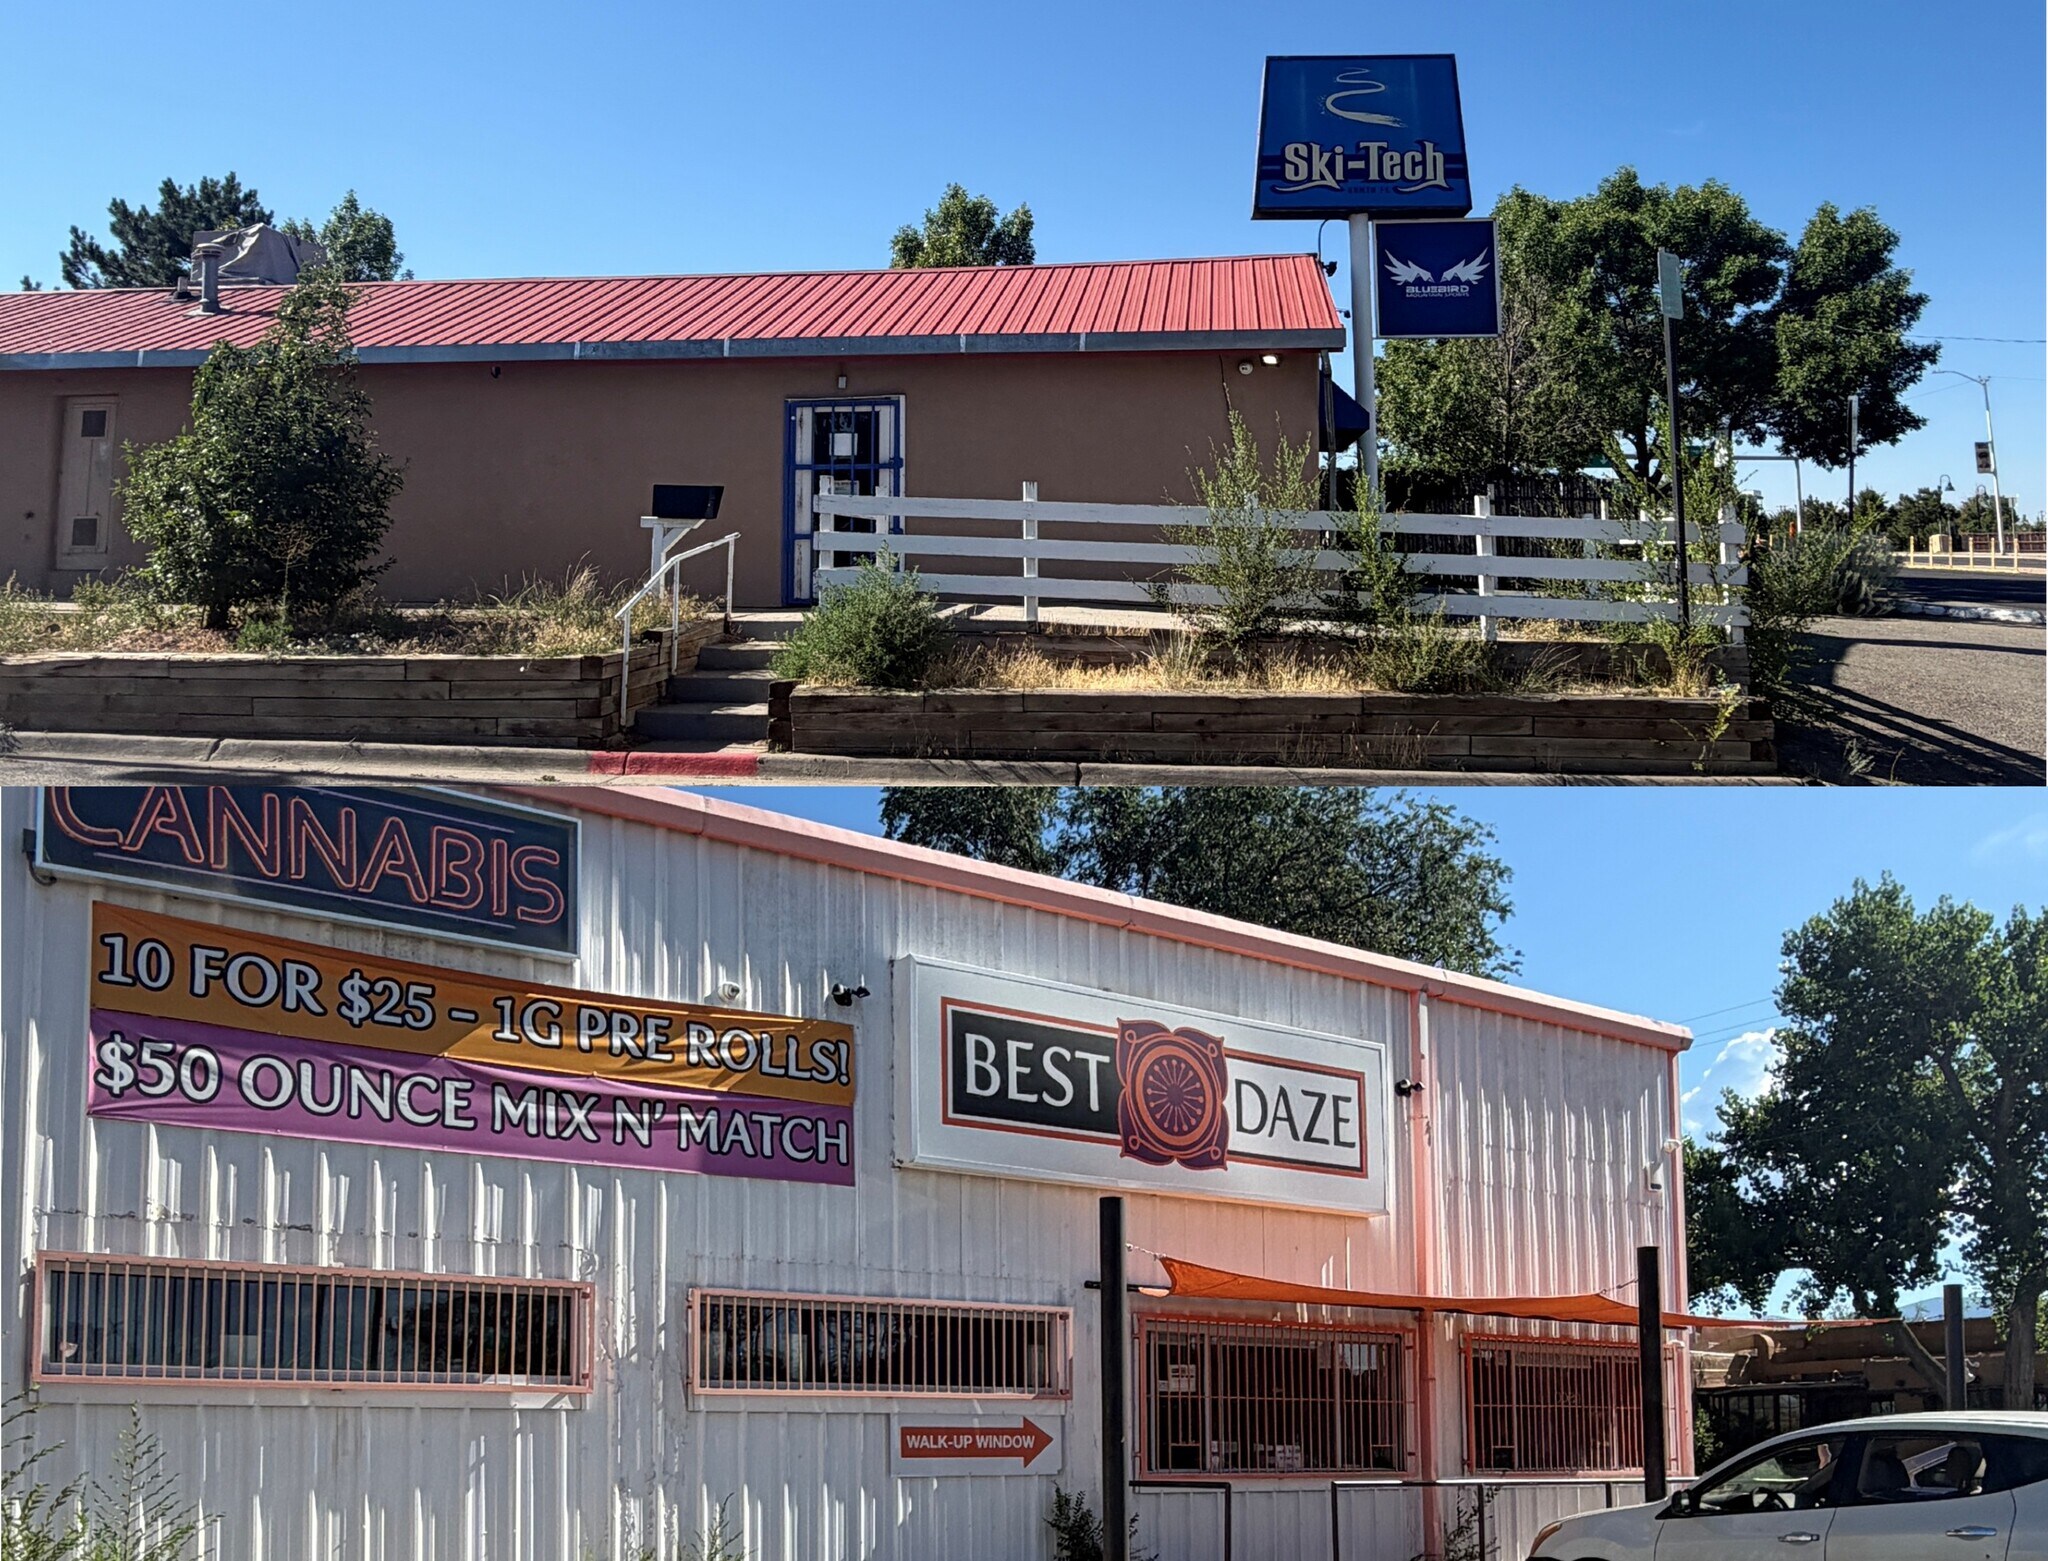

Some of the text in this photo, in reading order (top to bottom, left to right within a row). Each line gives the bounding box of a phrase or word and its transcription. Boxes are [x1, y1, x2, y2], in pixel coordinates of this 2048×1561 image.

[1274, 140, 1451, 192] Ski-Tech
[1405, 285, 1470, 293] BLUEBIRD
[100, 932, 174, 991] 10
[189, 944, 327, 1016] FOR
[337, 968, 436, 1030] $25
[492, 995, 563, 1050] 1G
[576, 1005, 675, 1063] PRE
[686, 1020, 851, 1085] ROLLS!
[95, 1031, 222, 1103] $50
[238, 1054, 478, 1131] OUNCE
[491, 1082, 599, 1142] MIX
[677, 1104, 850, 1167] MATCH
[964, 1033, 1358, 1149] BEST DAZE
[906, 1434, 1035, 1449] WALK-UP WINDOW
